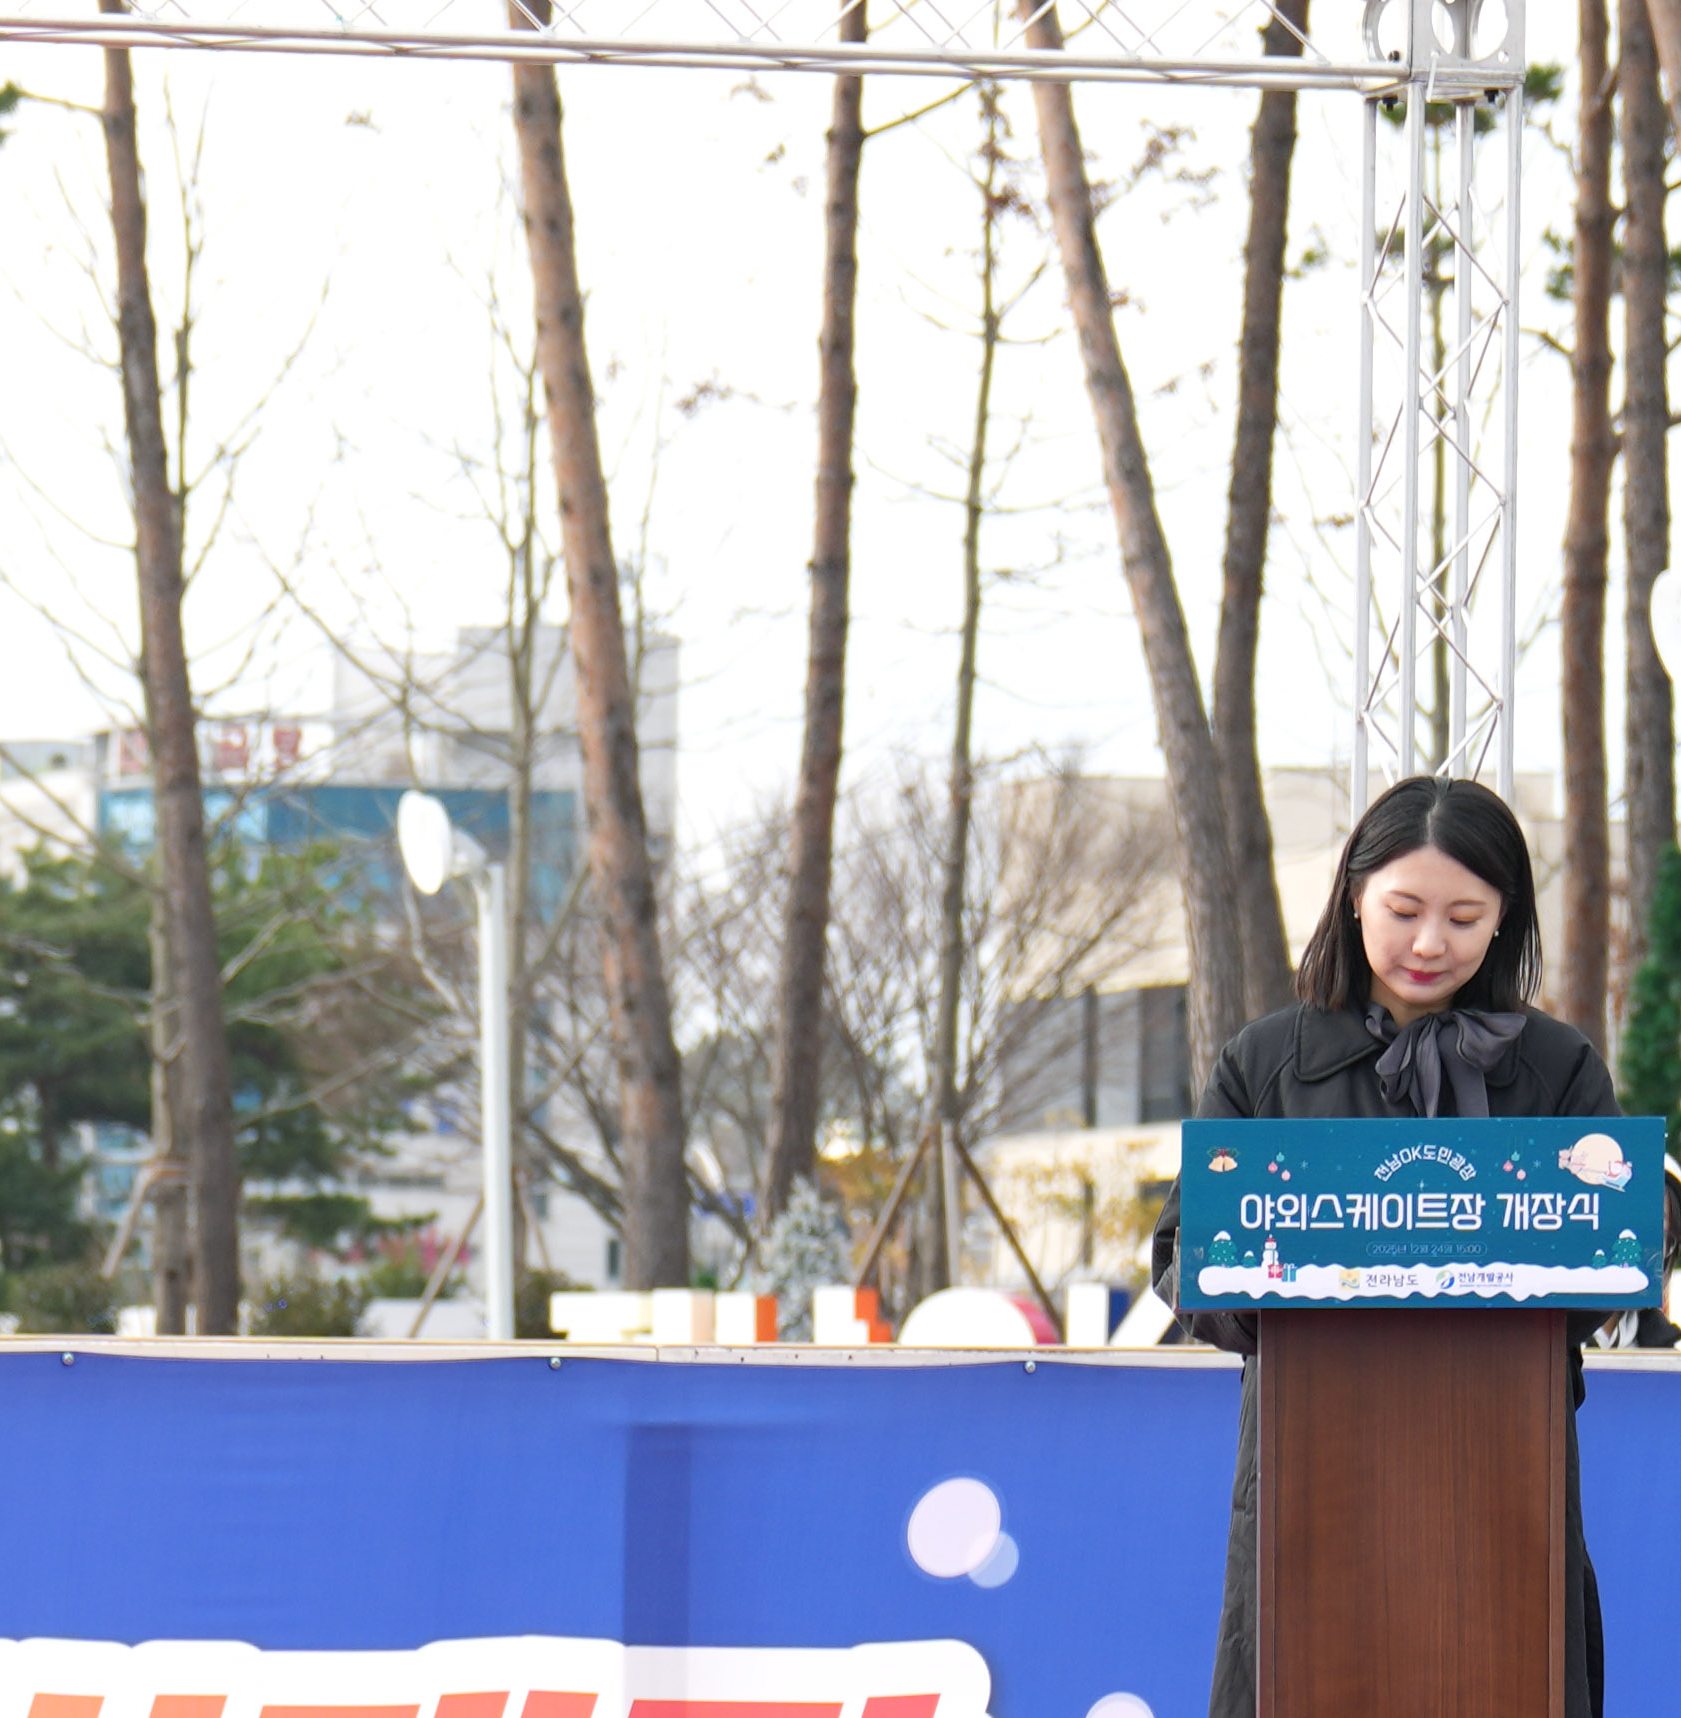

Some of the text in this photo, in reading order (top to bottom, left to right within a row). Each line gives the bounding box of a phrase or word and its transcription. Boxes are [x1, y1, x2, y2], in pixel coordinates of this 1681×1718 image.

[1373, 1144, 1478, 1182] 전남OK도민광장
[1240, 1191, 1600, 1232] 야외스케이트장 개장식
[1365, 1273, 1419, 1288] 전라남도
[1457, 1271, 1514, 1283] 전남개발공사
